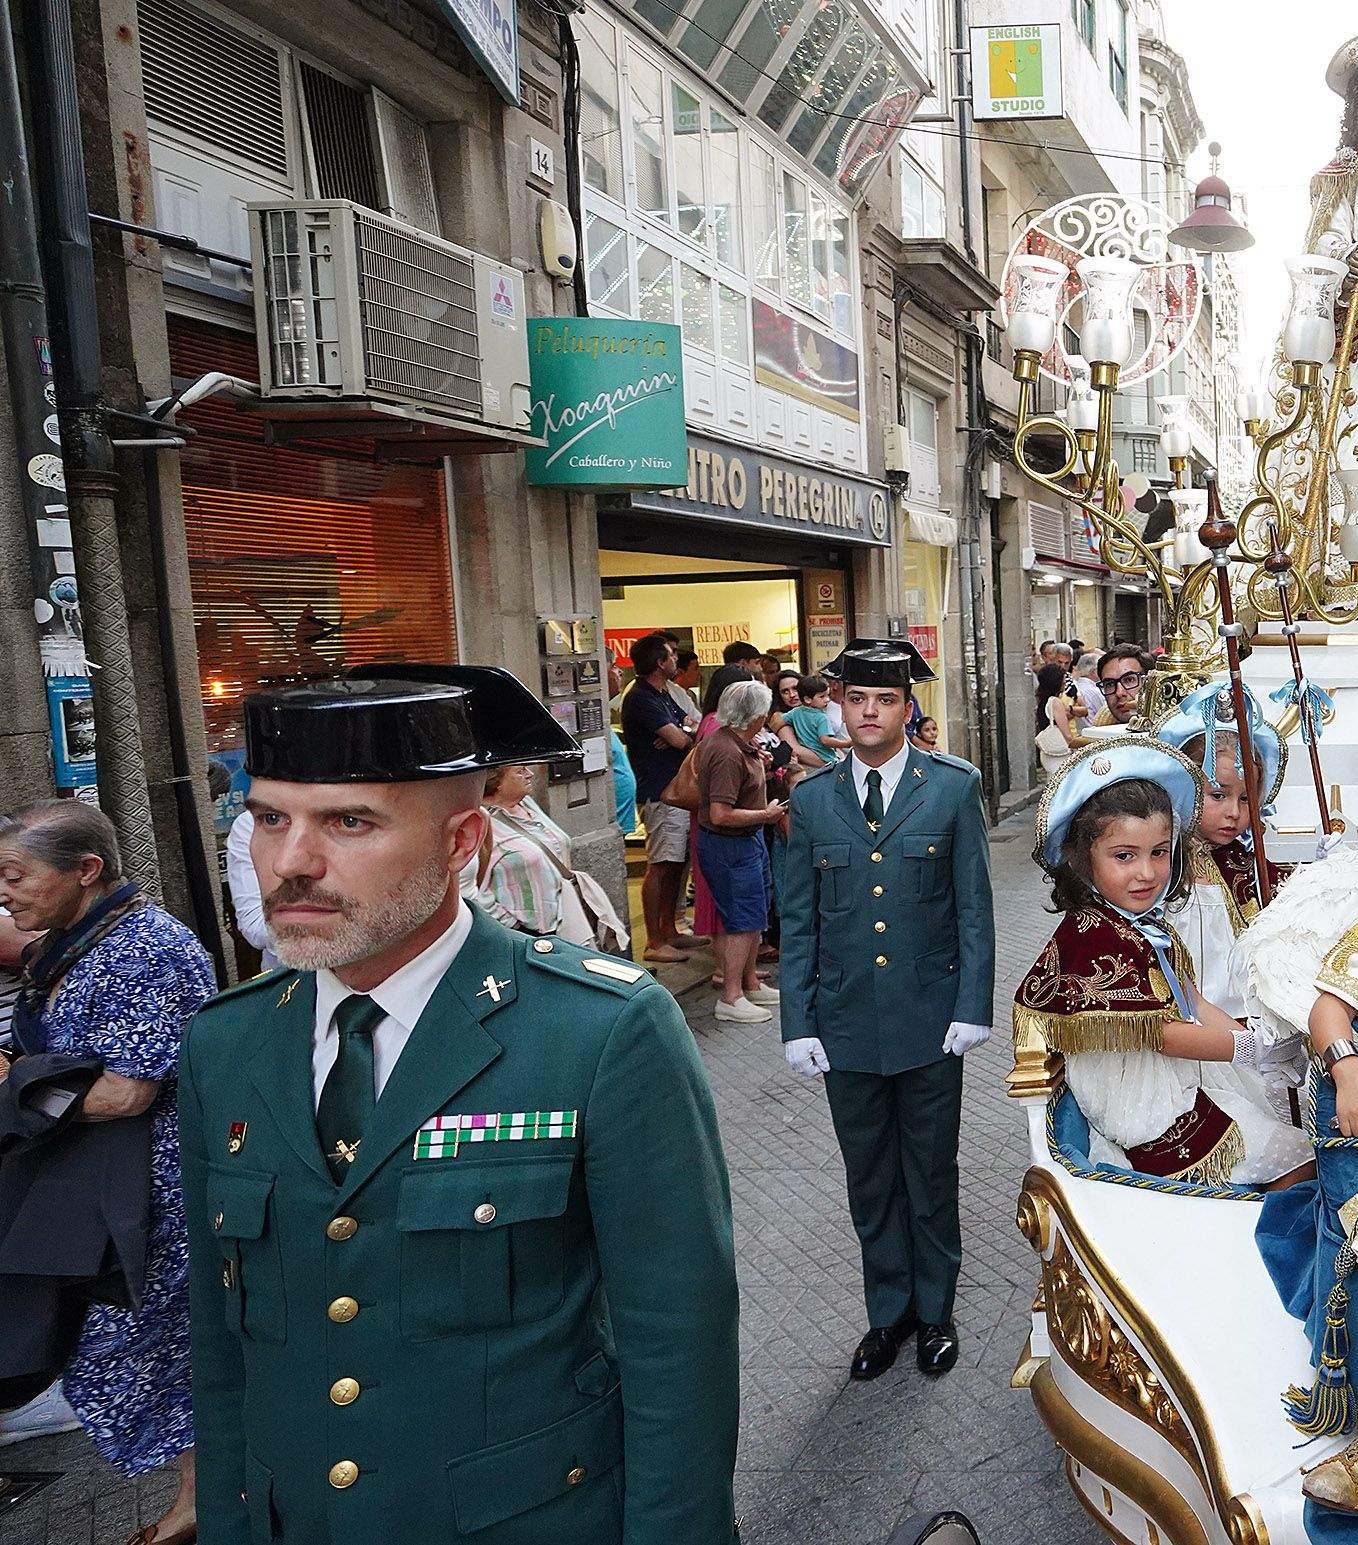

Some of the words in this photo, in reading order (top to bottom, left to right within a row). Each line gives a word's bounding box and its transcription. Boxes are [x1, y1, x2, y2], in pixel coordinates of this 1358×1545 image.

[987, 27, 1041, 39] ENGLISH
[991, 99, 1045, 112] STUDIO
[535, 149, 549, 175] 14
[569, 455, 625, 468] Caballero
[627, 458, 637, 472] y
[641, 457, 672, 469] Niño
[695, 622, 750, 643] REBAJAS
